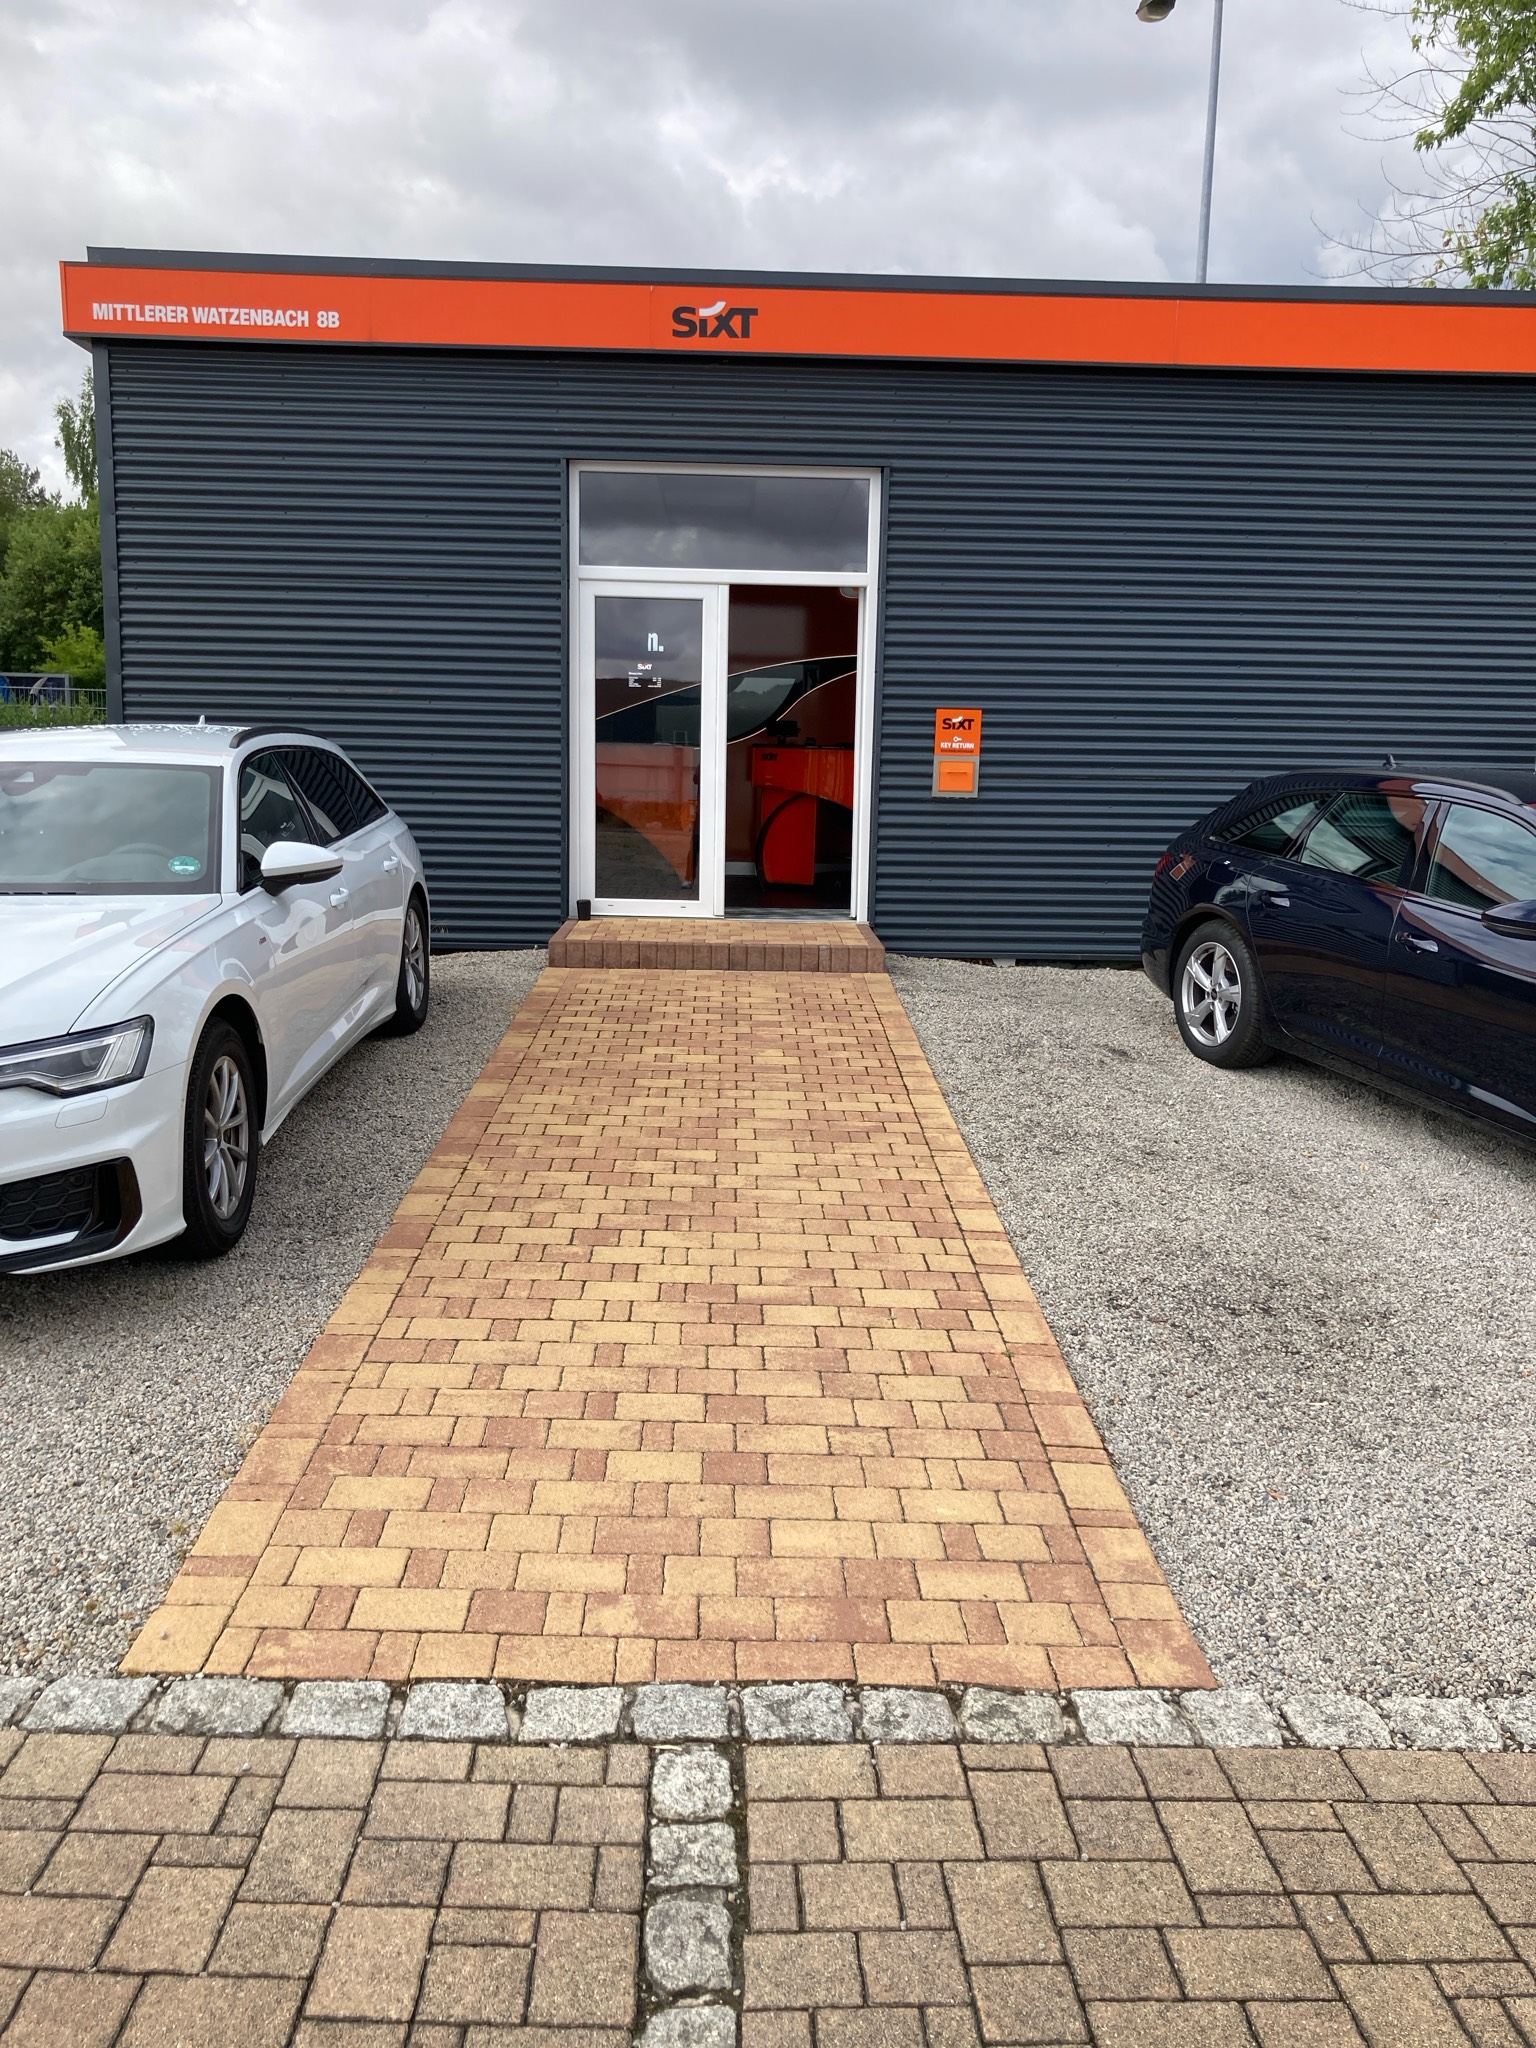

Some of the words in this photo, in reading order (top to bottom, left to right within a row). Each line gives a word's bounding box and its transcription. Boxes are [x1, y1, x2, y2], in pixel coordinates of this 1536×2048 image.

[92, 302, 188, 324] MITTLERER
[192, 306, 309, 328] WATZENBACH
[316, 310, 340, 328] 8B
